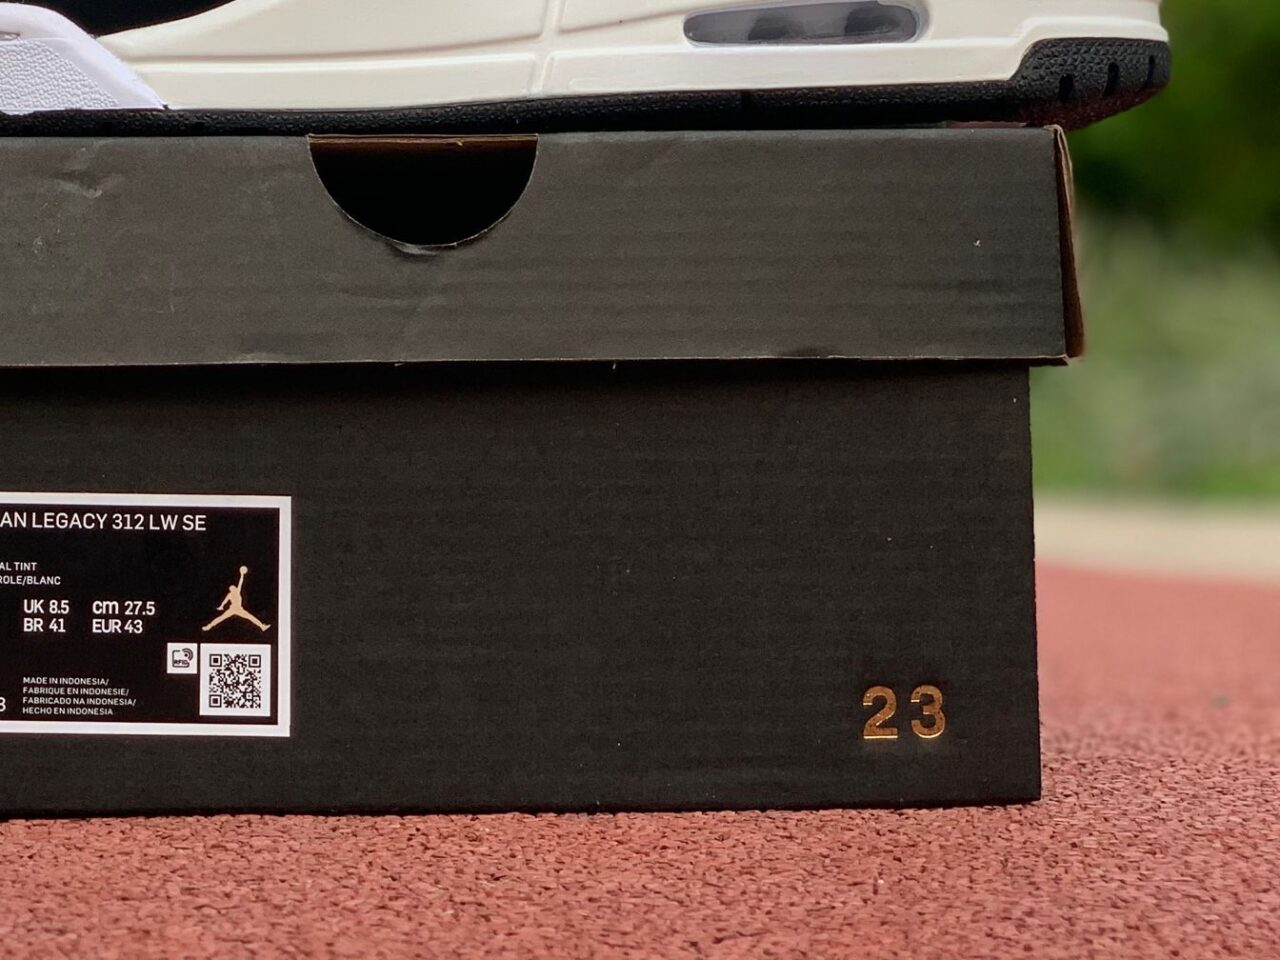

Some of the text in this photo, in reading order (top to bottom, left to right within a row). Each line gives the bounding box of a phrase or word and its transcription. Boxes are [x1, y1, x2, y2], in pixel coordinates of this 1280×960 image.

[32, 512, 108, 530] LEGACY
[112, 513, 145, 530] 312
[149, 514, 178, 530] LW
[182, 515, 207, 531] SE
[14, 561, 38, 571] TINT
[23, 599, 70, 614] UK 8.5
[92, 600, 156, 615] cm 27.5
[23, 618, 66, 632] BR 41
[92, 619, 143, 633] EUR 43
[23, 677, 110, 686] MADE IN INDONESIA/
[23, 687, 65, 695] FABRIQUE
[67, 687, 79, 695] EN
[23, 697, 137, 707] FABRICADO NA INDONESIA/
[23, 707, 114, 715] HECHO EN INDONESIA
[862, 685, 946, 739] 23
